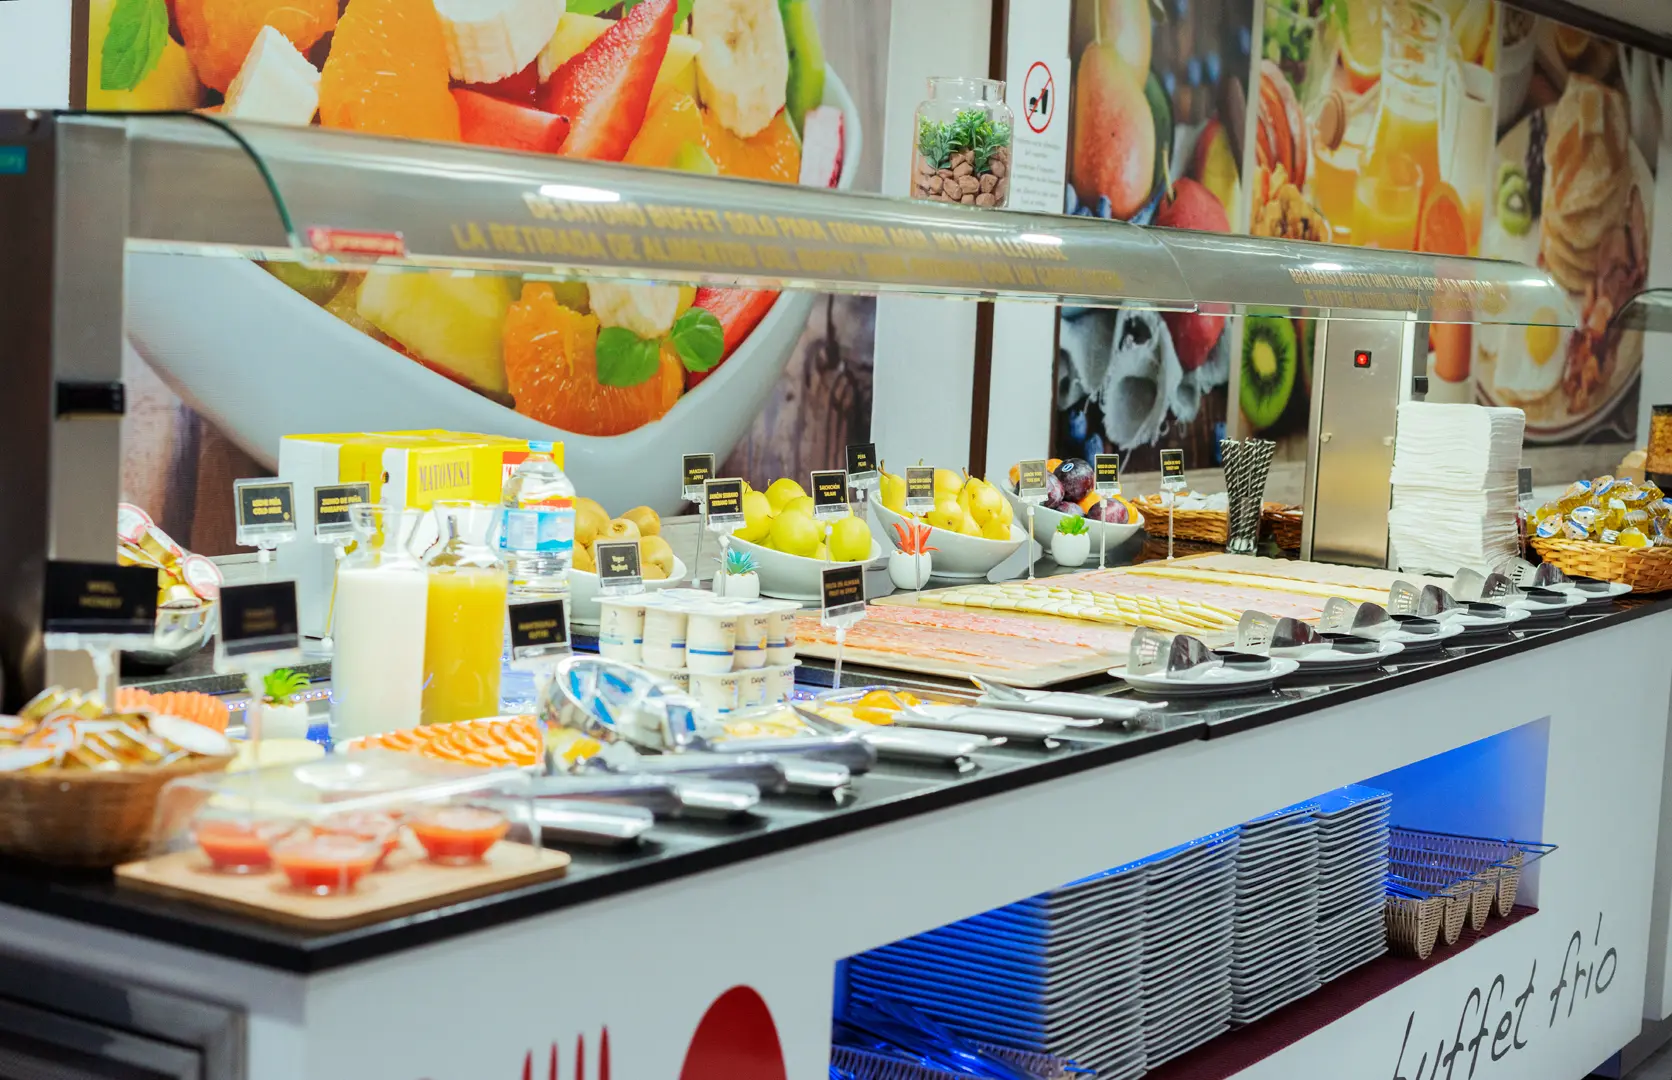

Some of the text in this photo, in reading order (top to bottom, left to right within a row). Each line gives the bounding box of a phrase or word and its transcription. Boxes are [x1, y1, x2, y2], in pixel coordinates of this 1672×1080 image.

[452, 222, 488, 250] LA
[489, 224, 606, 258] RETIRADA
[607, 233, 640, 259] DE
[523, 193, 646, 227] DESAYUNO
[646, 204, 723, 232] BUFFET
[725, 211, 777, 237] SOLO
[777, 216, 827, 242] PARA
[828, 221, 892, 246] TOMAR
[960, 232, 997, 253] PARA
[1288, 268, 1338, 285] BREAKFAST
[1338, 272, 1369, 286] BUFFET
[419, 462, 470, 491] MAYONESA
[1549, 912, 1617, 1028] frío
